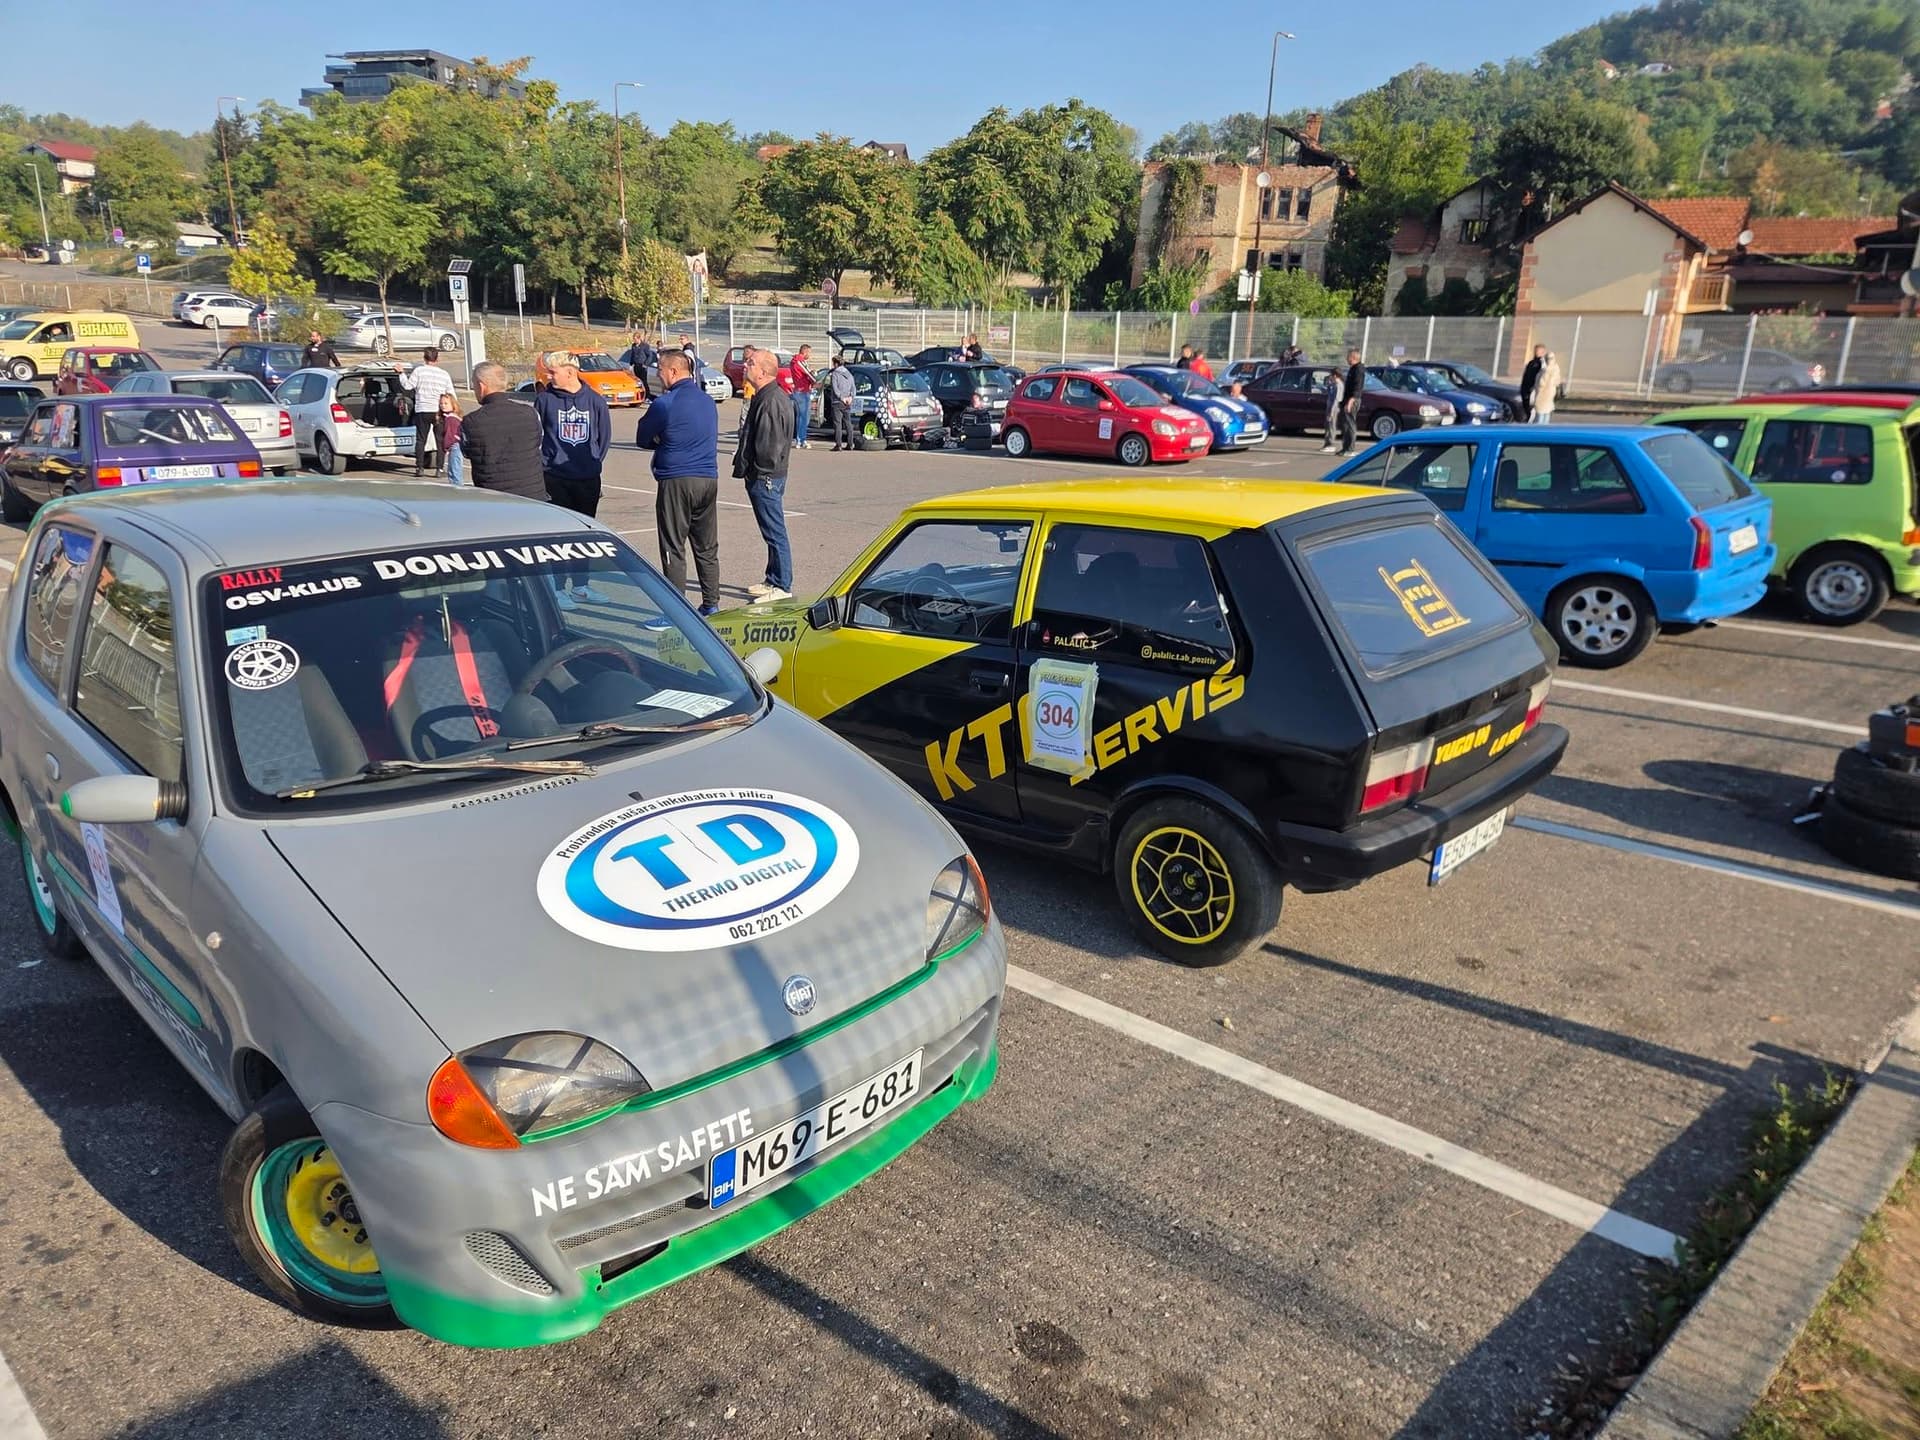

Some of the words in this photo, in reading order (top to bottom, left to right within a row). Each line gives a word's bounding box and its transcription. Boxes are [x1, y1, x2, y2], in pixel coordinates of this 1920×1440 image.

[79, 323, 128, 336] BIHAMK
[562, 423, 586, 438] NFL
[373, 550, 506, 581] DONJI
[504, 541, 618, 565] VAKUF
[219, 566, 284, 590] RALLY
[225, 576, 363, 610] OSV-KLUB
[742, 622, 797, 645] Santos
[232, 642, 283, 661] OSV-KLUB
[236, 675, 267, 687] DONJI
[269, 662, 295, 684] VAKUF
[1040, 702, 1074, 728] 304
[924, 702, 1012, 801] KT
[556, 818, 618, 859] Proizvodnja
[617, 802, 657, 822] sušara
[658, 790, 727, 808] inkubatora
[729, 790, 735, 798] i
[738, 790, 774, 800] pilica
[662, 878, 738, 913] THERMO
[743, 857, 806, 887] DIGITAL
[729, 921, 756, 940] 062
[756, 913, 781, 933] 222
[781, 903, 803, 924] 121
[790, 984, 812, 1005] FIAT
[742, 1060, 915, 1187] M69-E-681
[531, 1176, 577, 1217] NE
[585, 1156, 651, 1200] SAM
[658, 1107, 755, 1173] SAFETE
[713, 1179, 734, 1199] BIH
